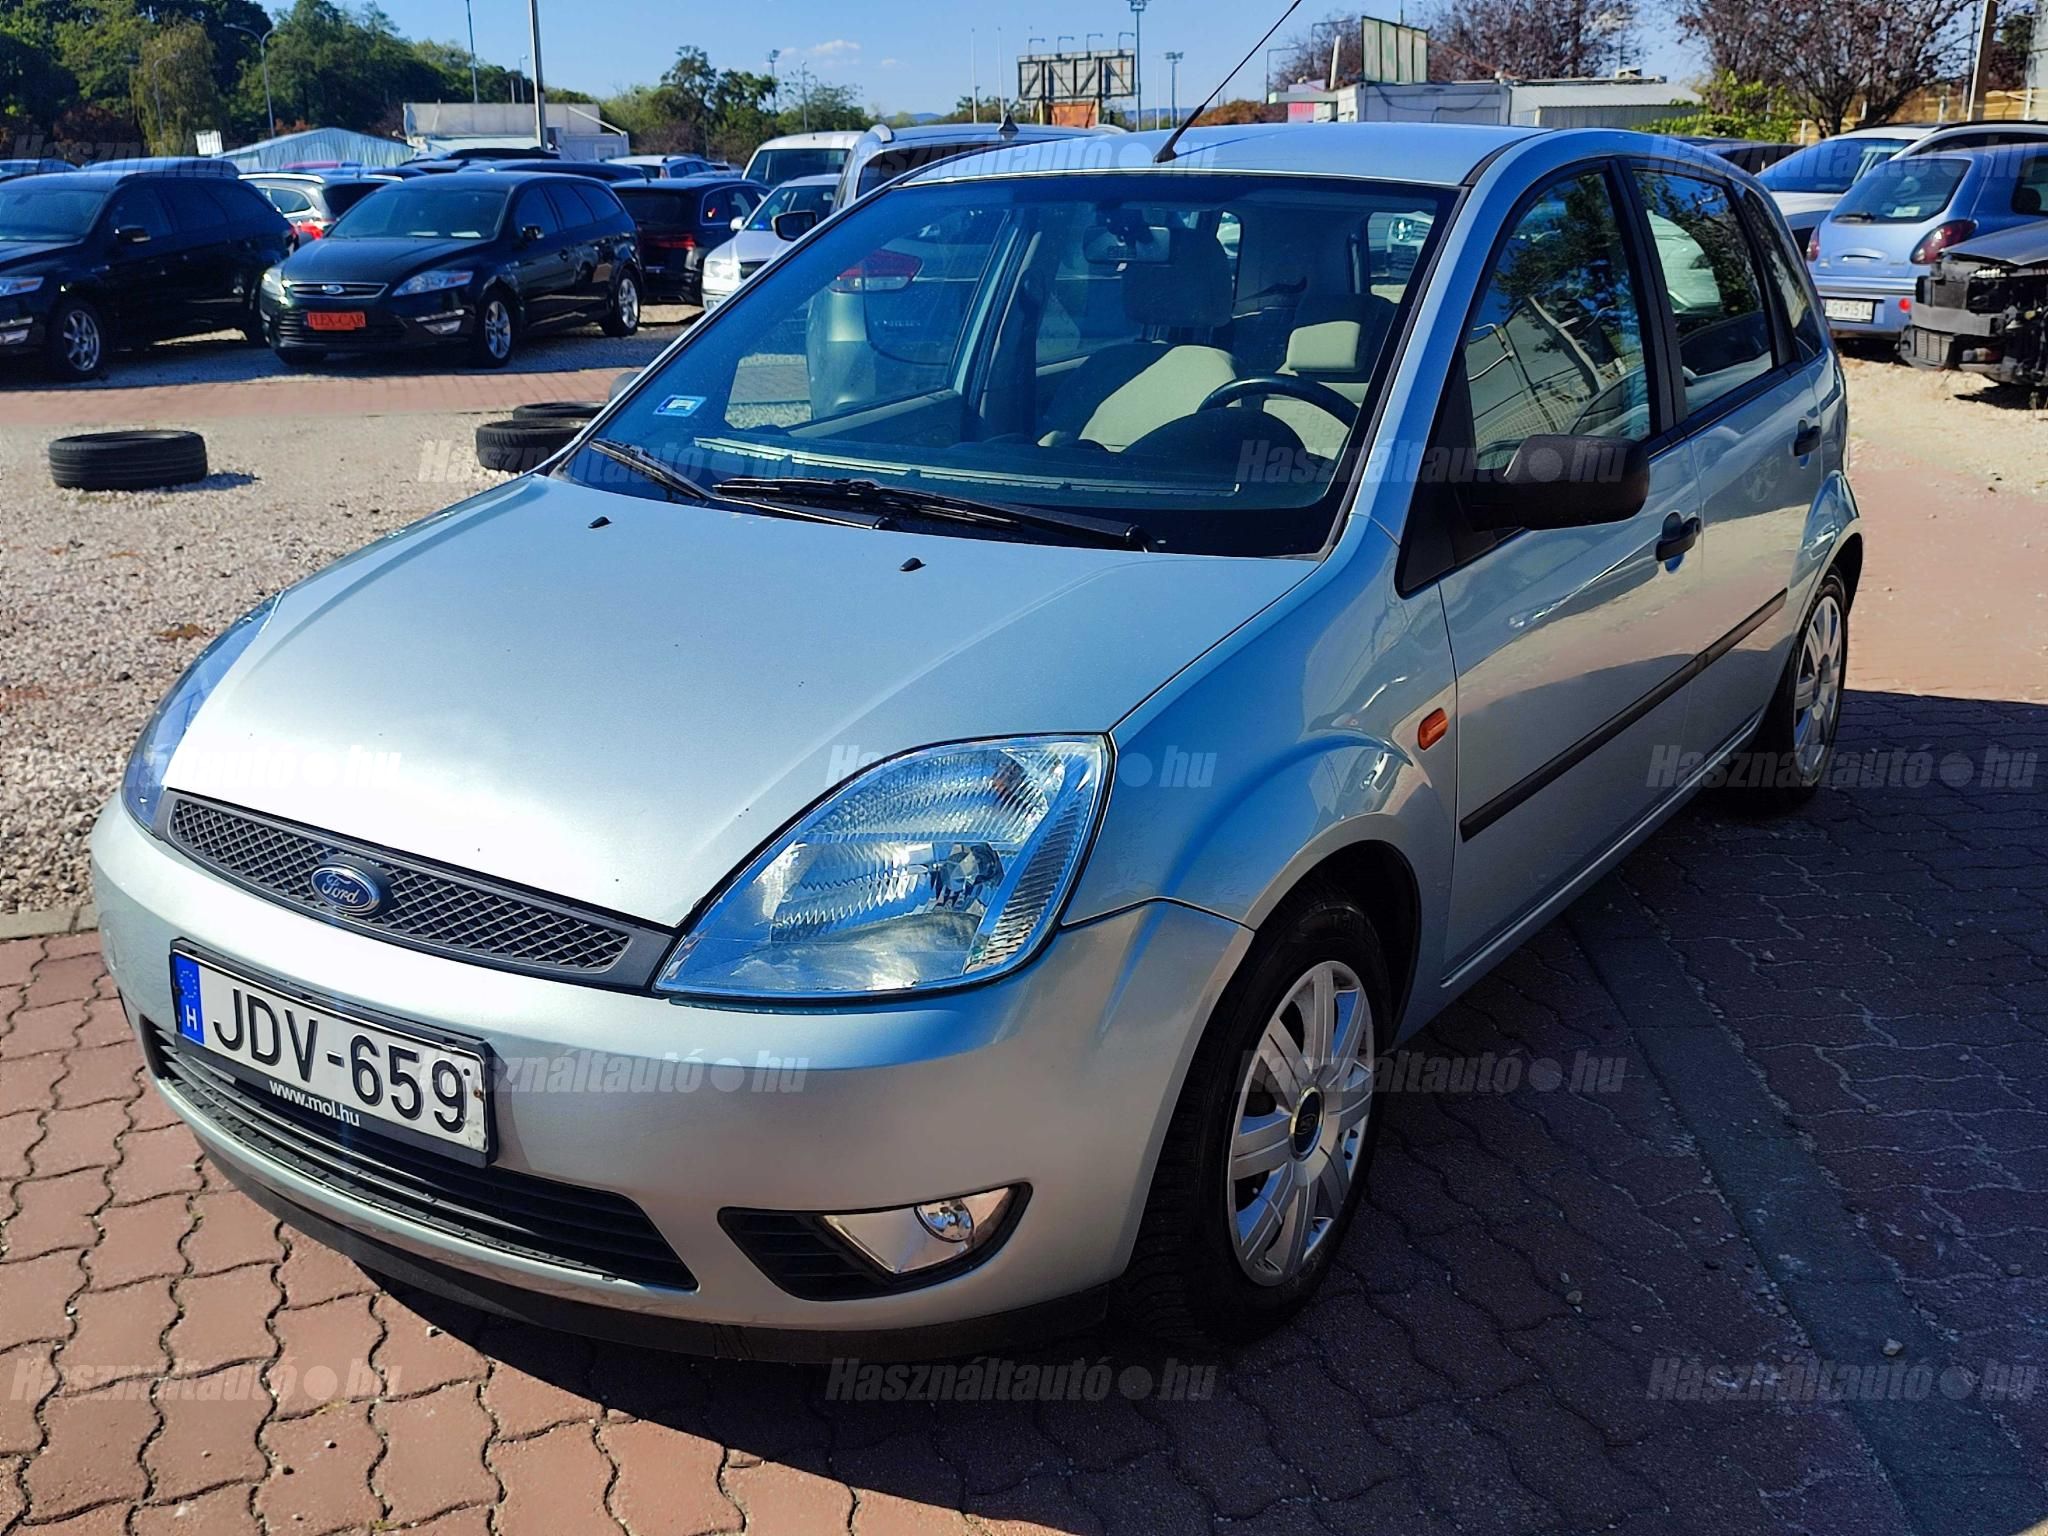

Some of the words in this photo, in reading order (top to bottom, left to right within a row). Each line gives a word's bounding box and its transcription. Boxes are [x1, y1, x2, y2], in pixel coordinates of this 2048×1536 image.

[320, 871, 361, 904] Ford
[185, 1004, 198, 1032] H
[213, 986, 466, 1134] JDV-659
[268, 1080, 361, 1127] www.mol.hu
